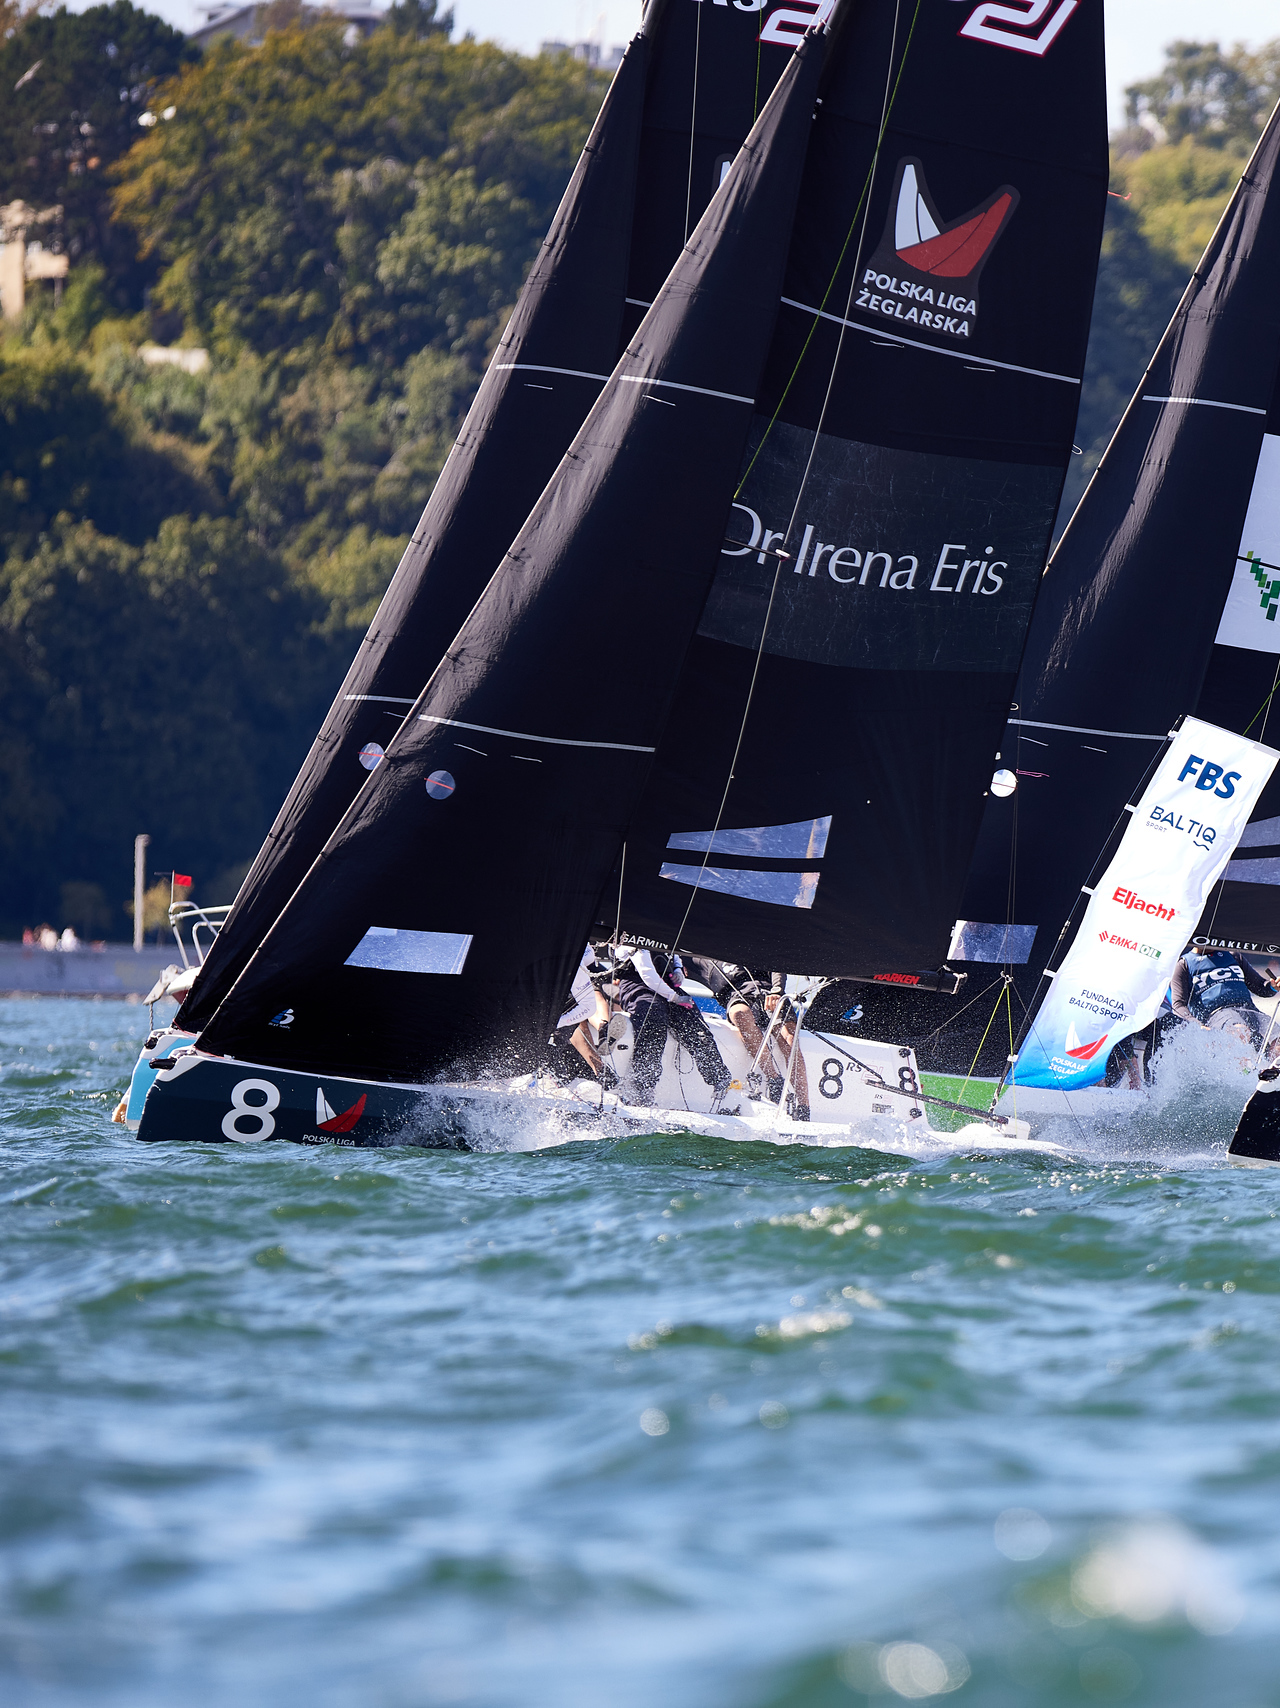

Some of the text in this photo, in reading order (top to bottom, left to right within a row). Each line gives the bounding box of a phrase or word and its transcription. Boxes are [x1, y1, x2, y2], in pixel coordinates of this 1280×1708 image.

[863, 269, 976, 316] POLSKA LIGA
[855, 288, 969, 337] ŻEGLARSKA
[794, 524, 919, 591] Irena
[929, 543, 1008, 595] Eris
[1177, 754, 1242, 799] FBS
[1145, 821, 1167, 833] SPORT
[1149, 805, 1217, 845] BALTIQ
[1112, 886, 1176, 922] Eljacht
[1109, 934, 1161, 960] EMKA OIL
[1210, 938, 1258, 951] OAKLEY
[1068, 997, 1129, 1022] BALTIQ SPORT
[1081, 989, 1125, 1011] FUNDACJA
[818, 1057, 844, 1100] 8
[898, 1066, 919, 1095] 8
[1052, 1056, 1077, 1069] POLSKA
[221, 1078, 280, 1143] 8
[302, 1134, 335, 1144] POLSKA
[336, 1138, 356, 1147] LIGA
